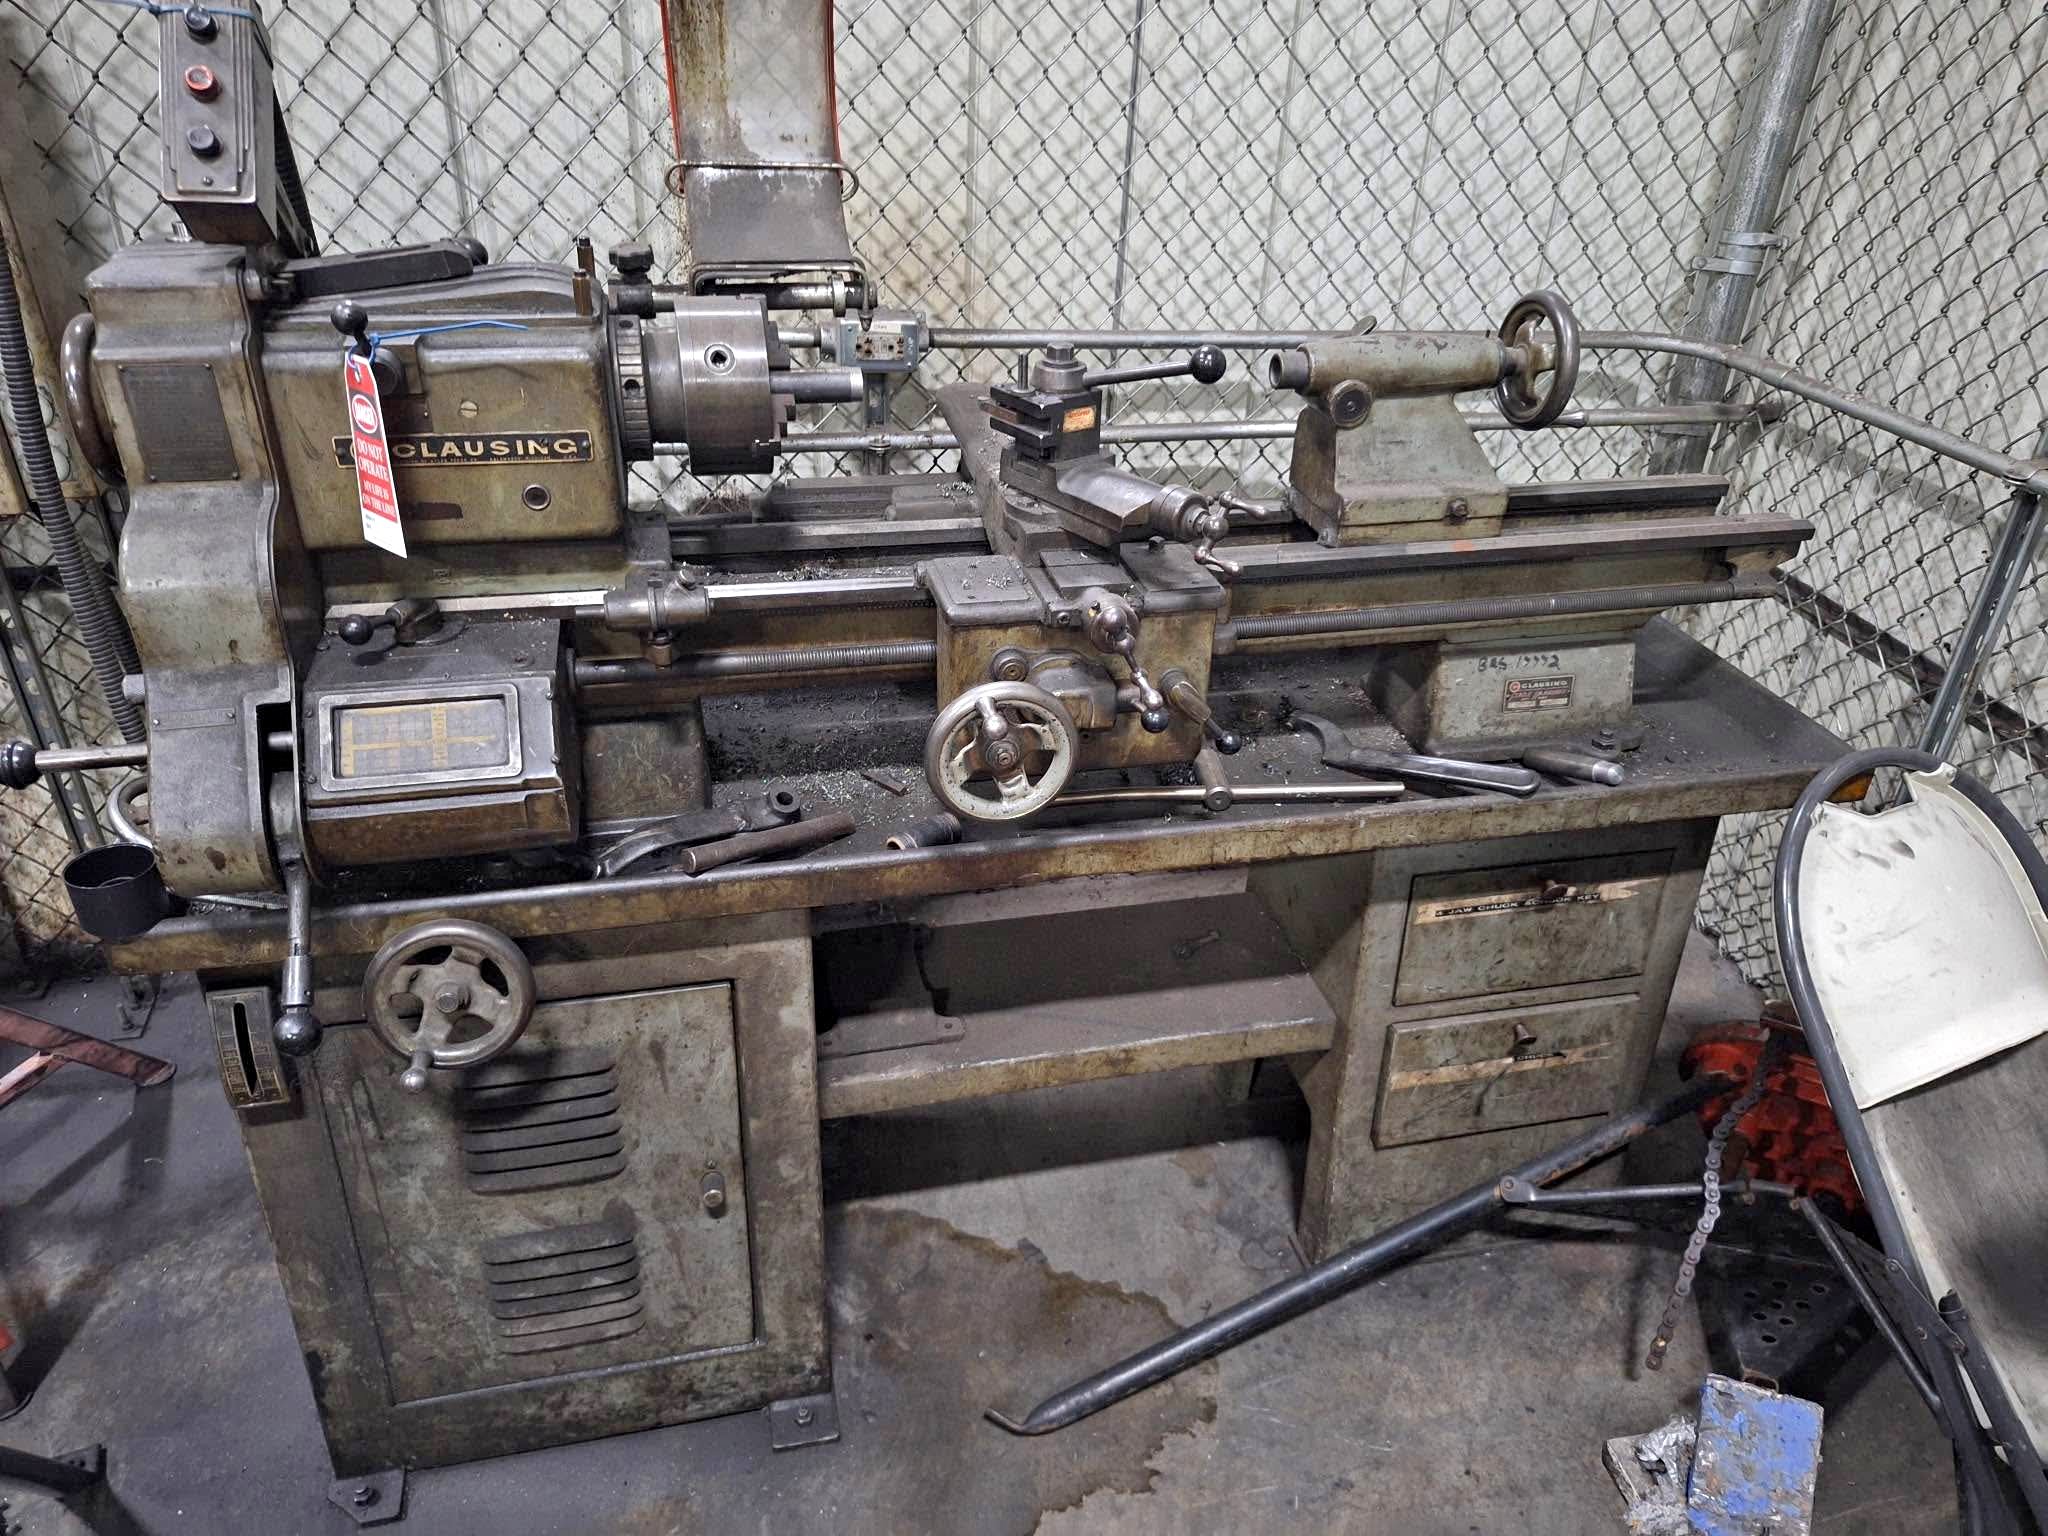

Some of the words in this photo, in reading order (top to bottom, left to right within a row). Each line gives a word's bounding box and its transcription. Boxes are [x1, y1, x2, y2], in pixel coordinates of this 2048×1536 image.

[357, 437, 368, 455] DO
[368, 443, 383, 462] NOT
[393, 438, 578, 458] CLAUSING
[358, 456, 389, 480] OPERATE
[1521, 680, 1568, 689] CLAUSING
[1448, 907, 1473, 915] JAW
[1477, 901, 1519, 911] CHUCK
[1577, 893, 1600, 901] KEY
